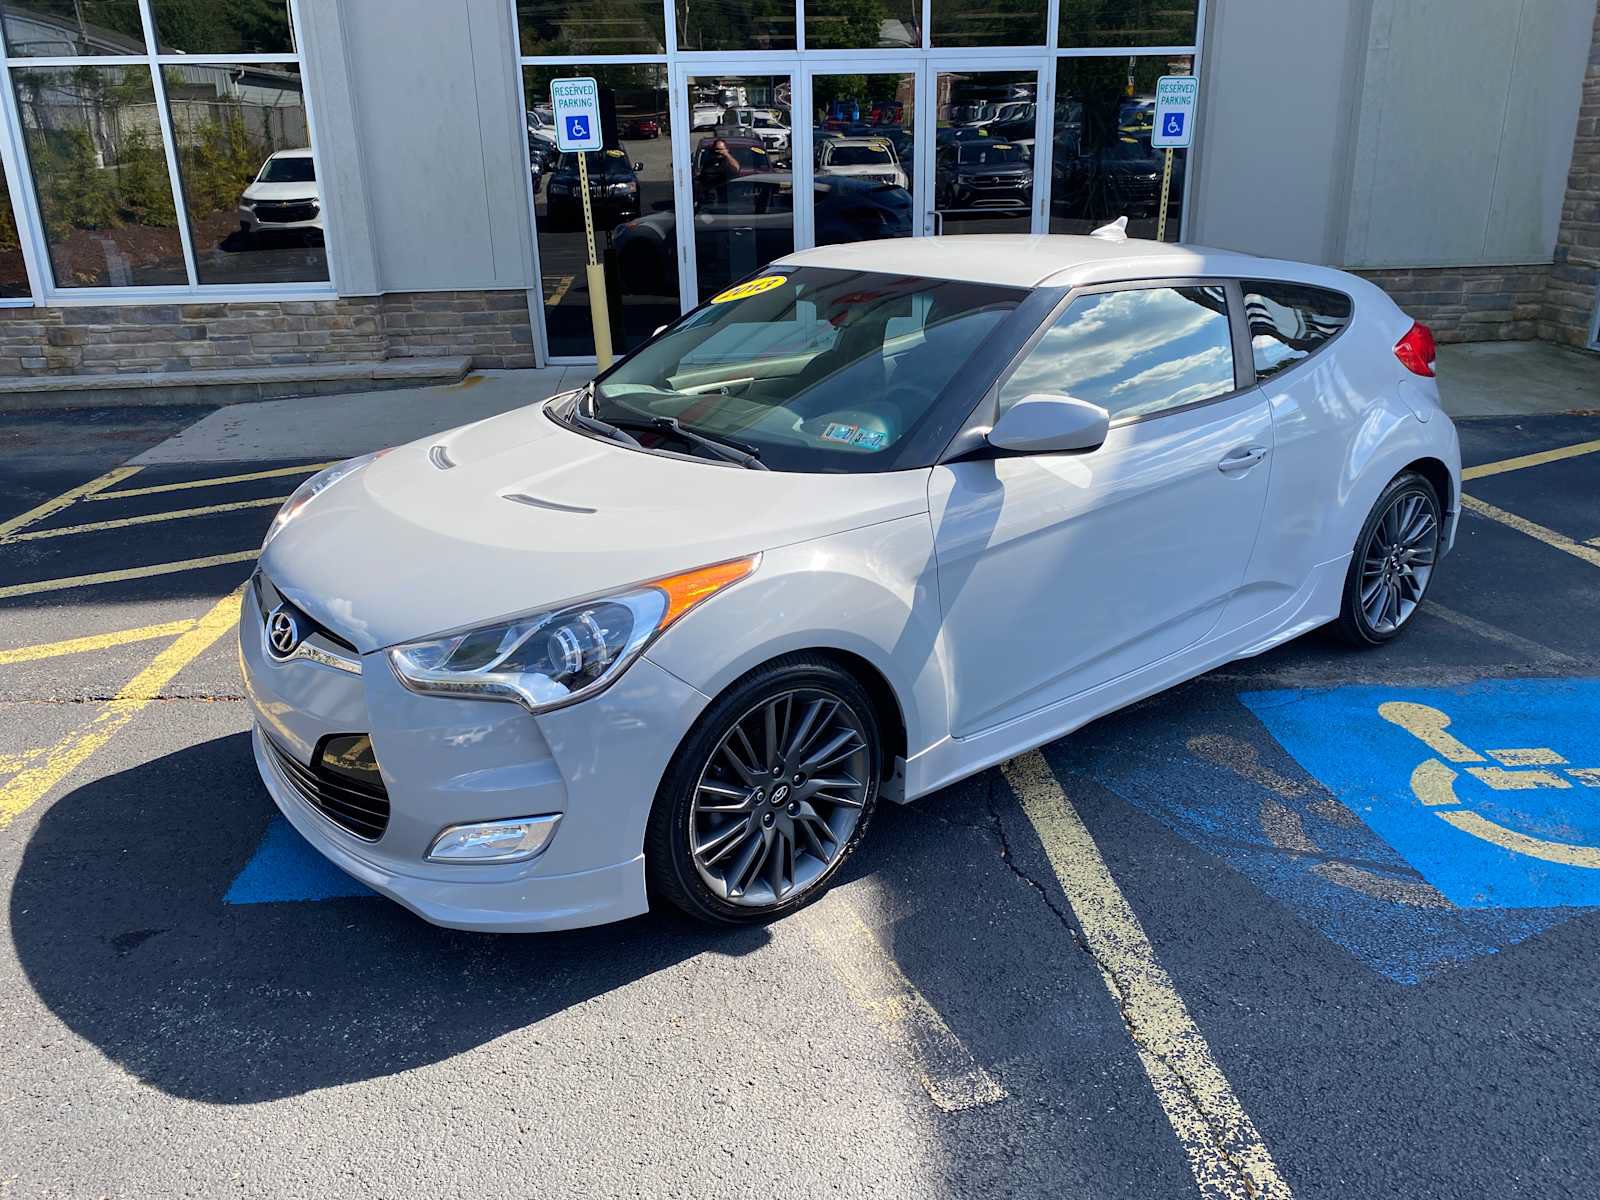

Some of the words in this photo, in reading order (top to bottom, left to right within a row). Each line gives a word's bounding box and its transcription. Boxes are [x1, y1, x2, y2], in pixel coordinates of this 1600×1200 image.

[555, 85, 594, 97] RESERVED
[1160, 84, 1194, 94] RESERVED
[558, 98, 592, 108] PARKING
[1161, 96, 1191, 105] PARKING
